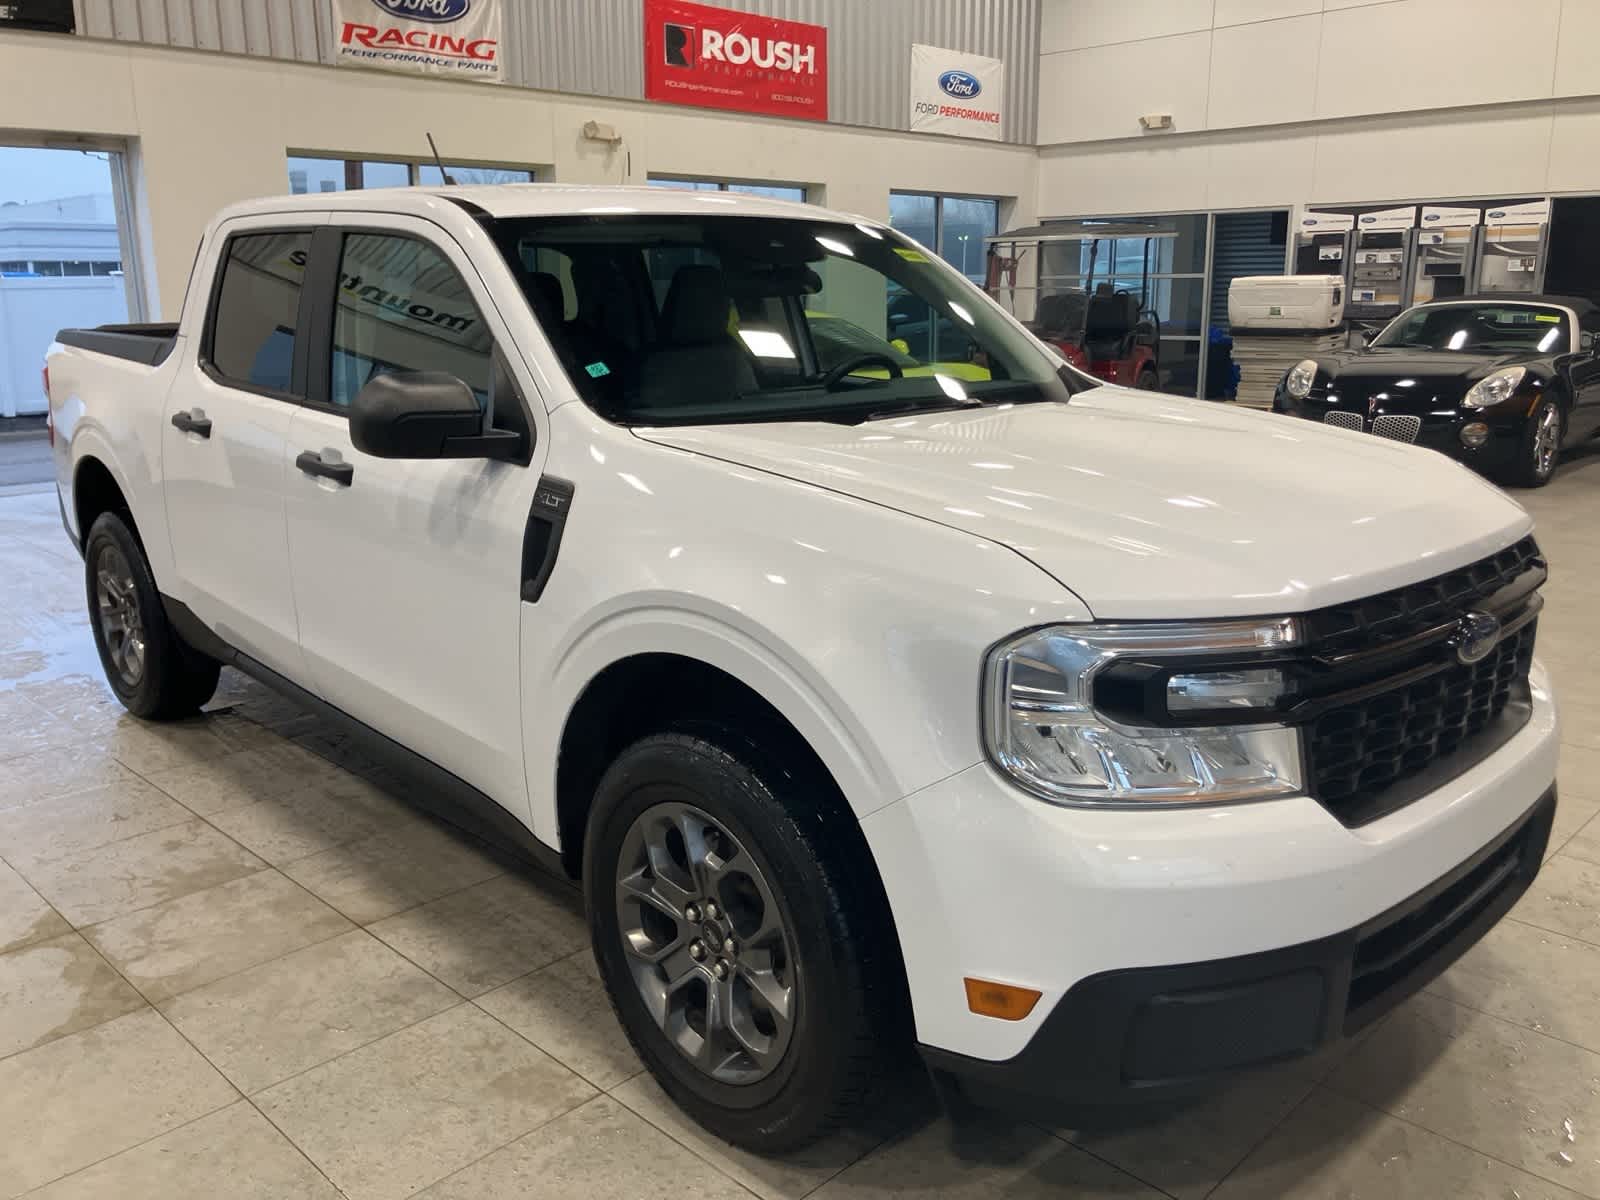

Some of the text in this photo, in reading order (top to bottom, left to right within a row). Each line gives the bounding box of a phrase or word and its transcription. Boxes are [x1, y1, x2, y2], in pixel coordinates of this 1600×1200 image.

[341, 22, 497, 60] RACING
[702, 28, 816, 74] ROUSH
[342, 47, 498, 72] PERFORMANCE PARTS
[915, 102, 1000, 123] FORD PERFORMANCE
